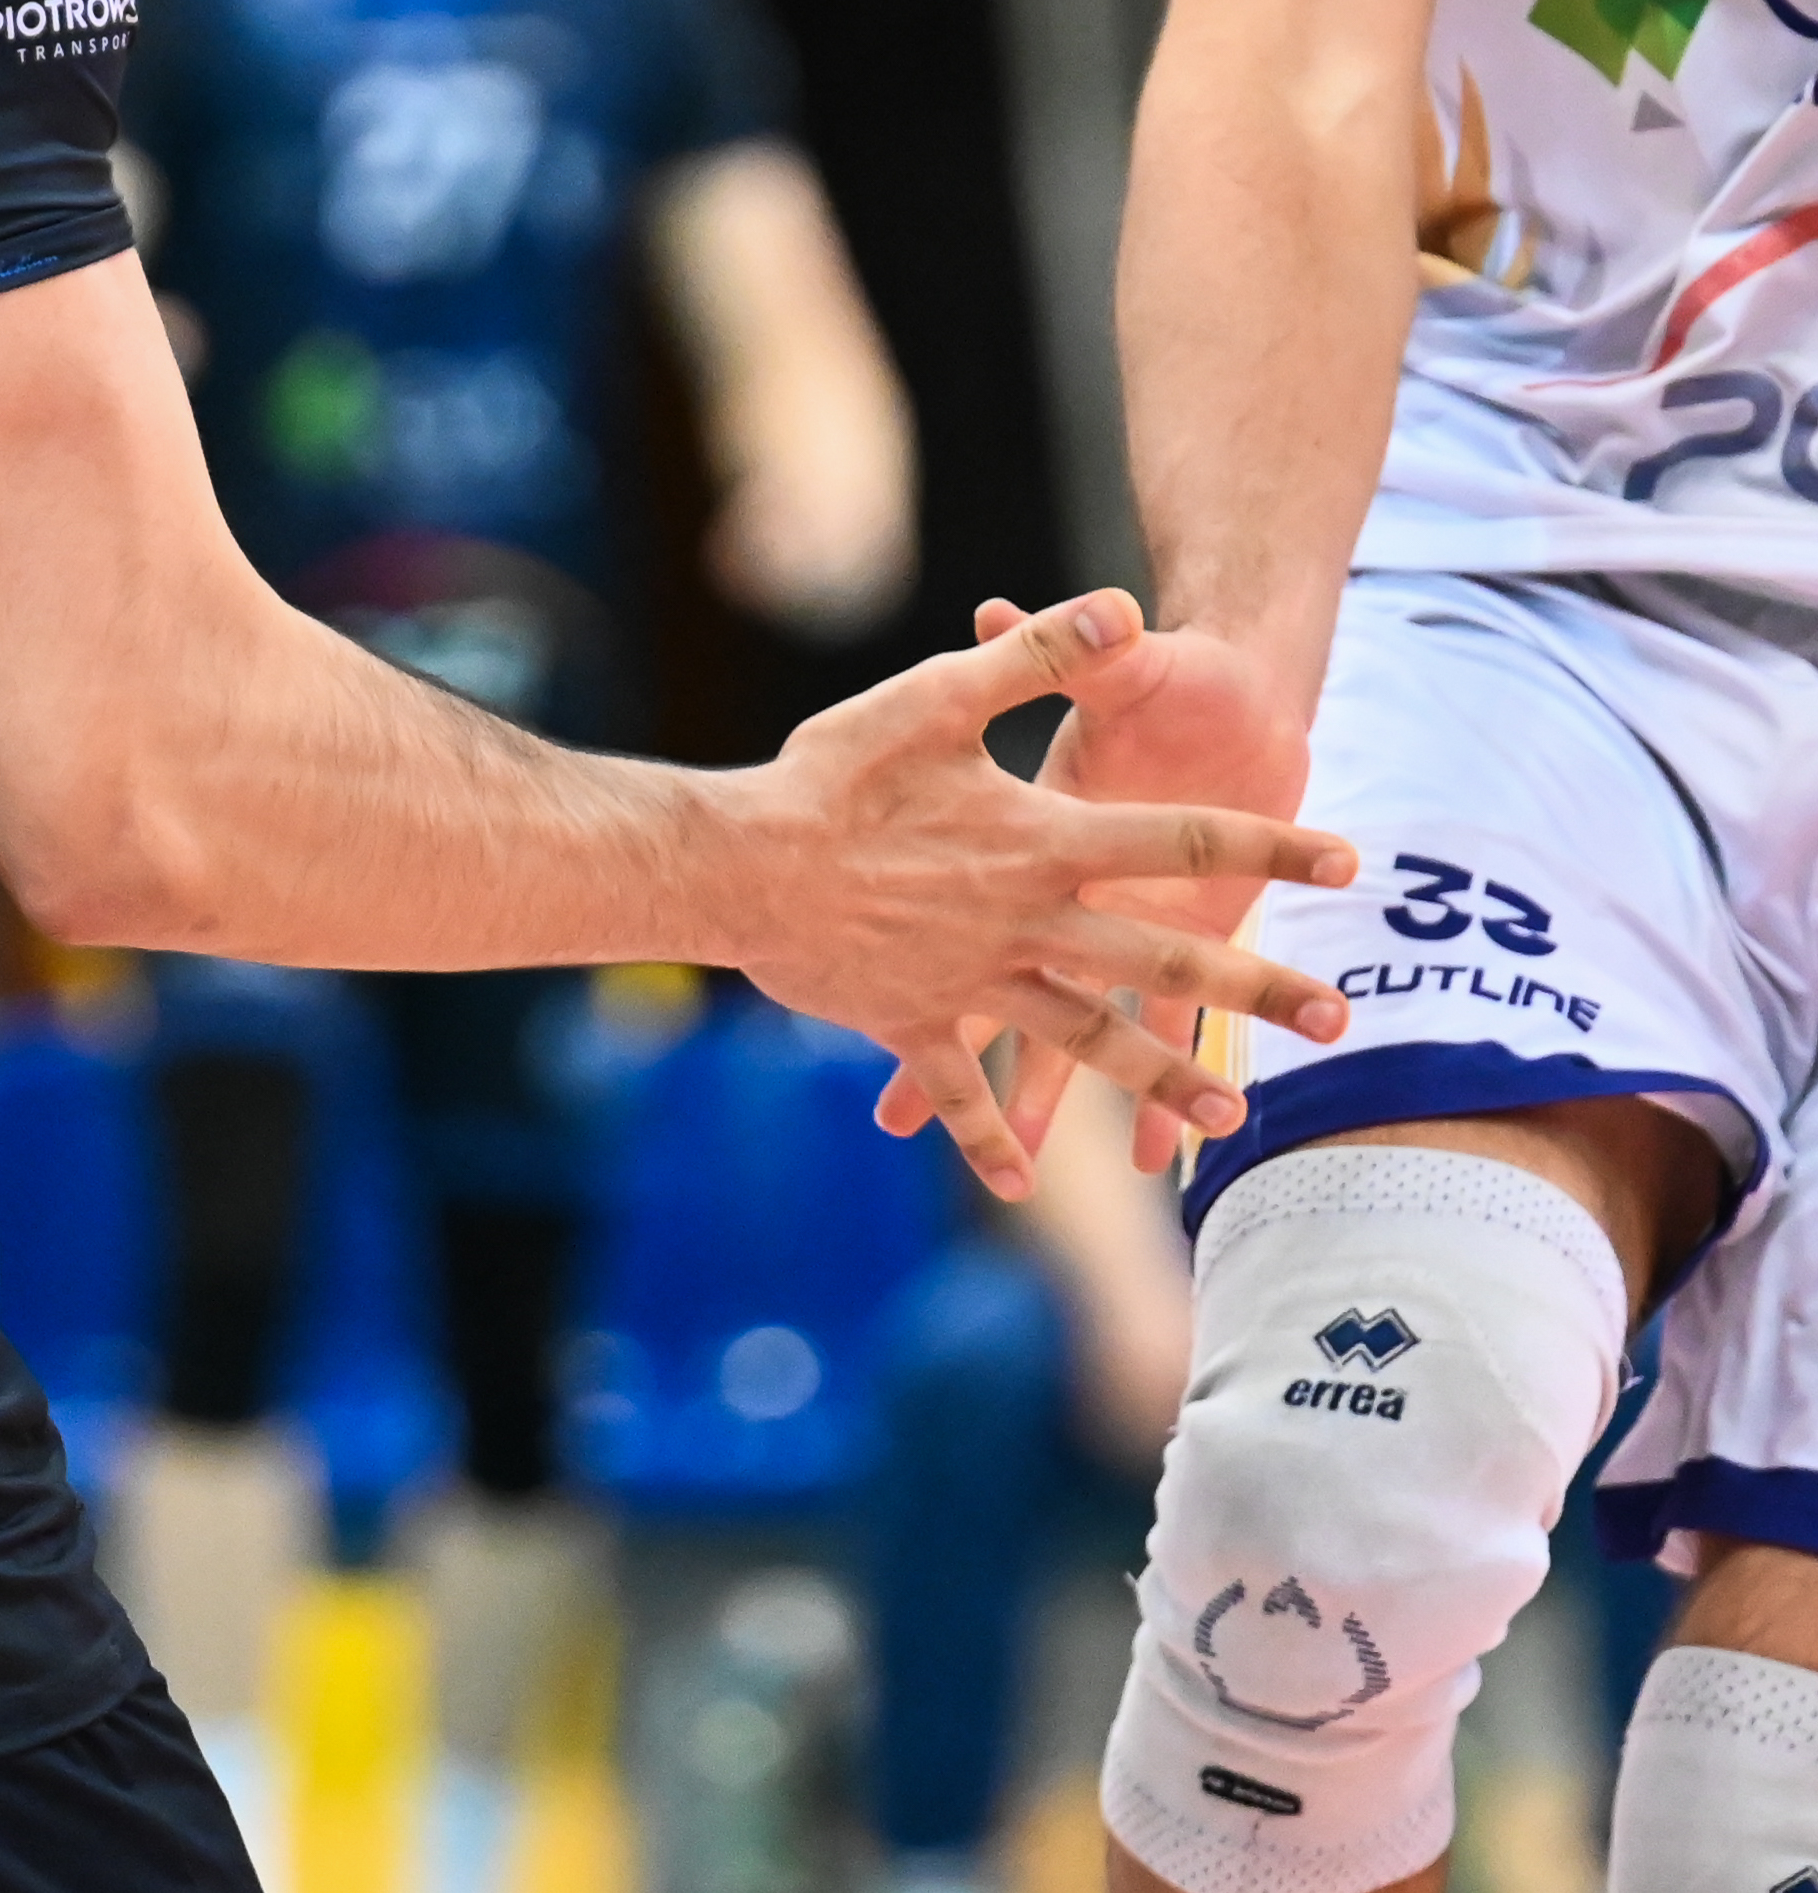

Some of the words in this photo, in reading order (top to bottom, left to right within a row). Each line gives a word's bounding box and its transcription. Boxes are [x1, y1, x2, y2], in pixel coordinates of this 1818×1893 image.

[1382, 852, 1559, 958] 33
[1337, 963, 1602, 1034] CUTLINE
[1283, 1378, 1409, 1422] errea
